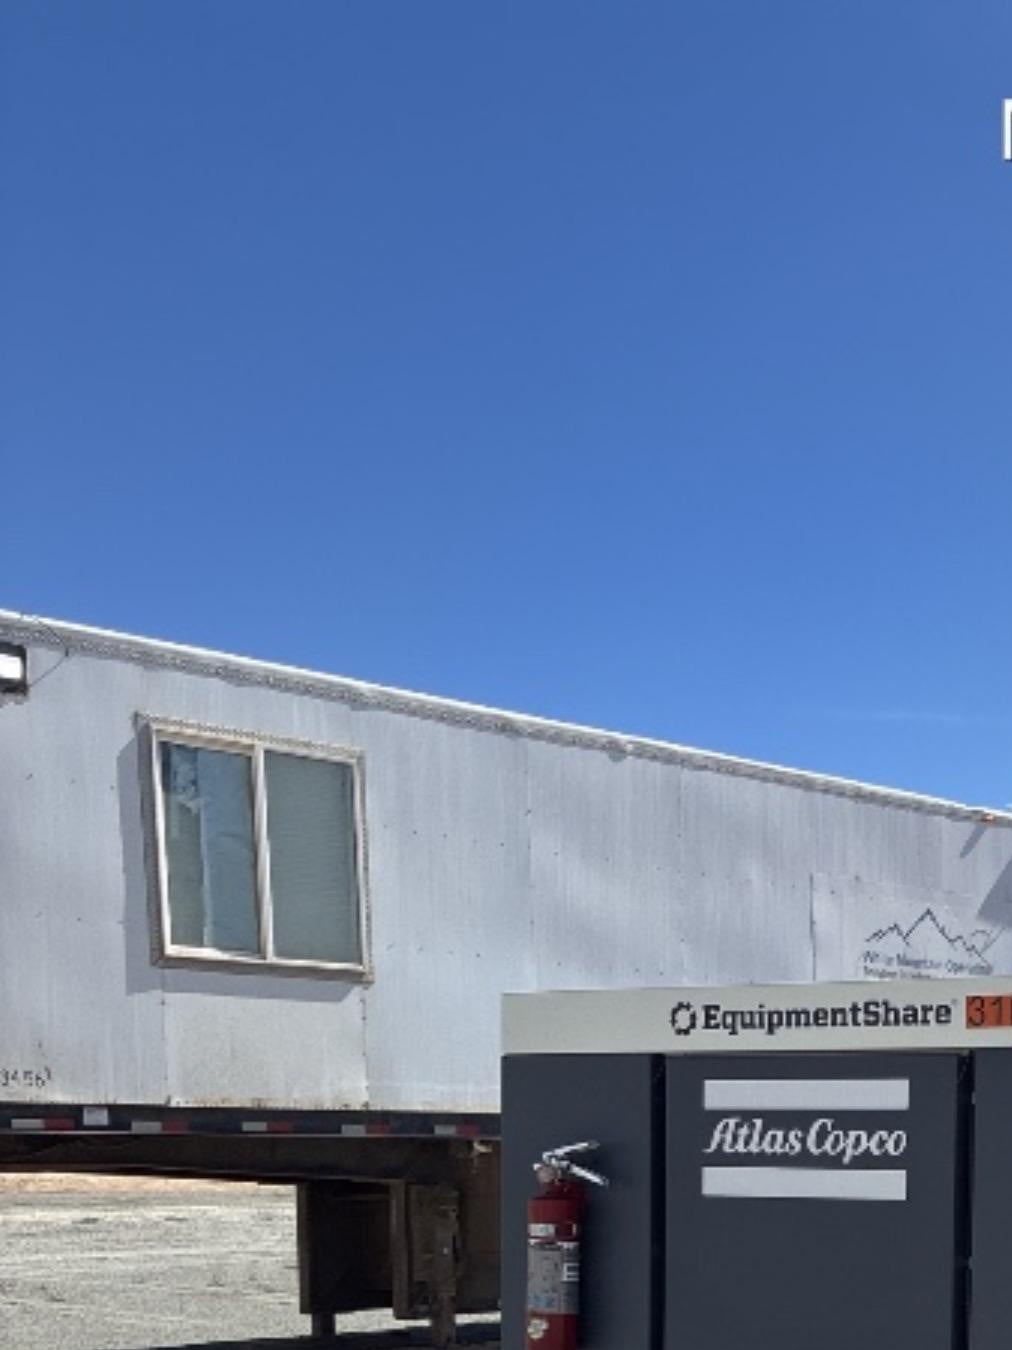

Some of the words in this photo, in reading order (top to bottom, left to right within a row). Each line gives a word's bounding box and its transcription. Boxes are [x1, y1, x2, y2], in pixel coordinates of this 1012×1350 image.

[702, 1000, 952, 1035] EquipmentShare
[703, 1117, 803, 1156] Atlas
[805, 1118, 907, 1165] Copco
